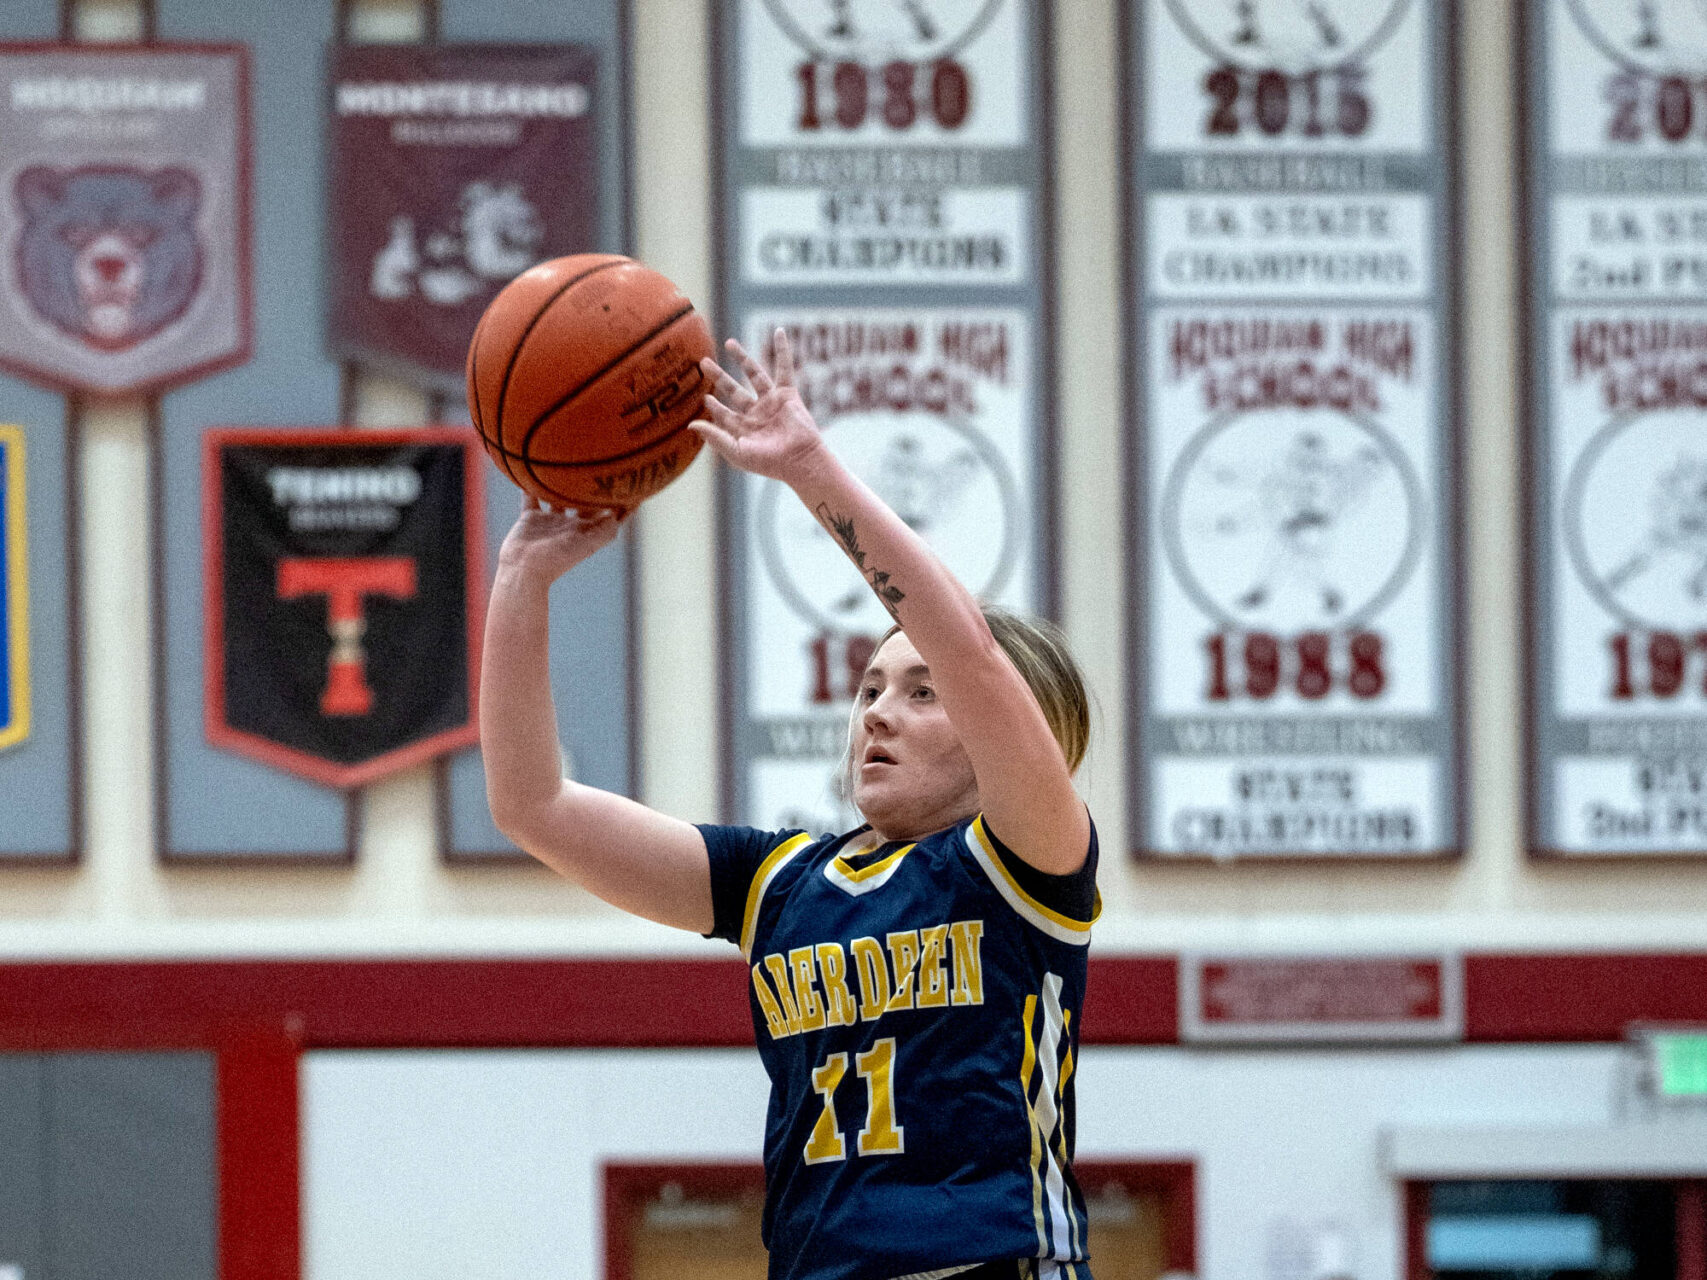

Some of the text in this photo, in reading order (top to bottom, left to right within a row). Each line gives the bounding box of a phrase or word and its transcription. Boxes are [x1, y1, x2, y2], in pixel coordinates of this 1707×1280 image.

[797, 58, 972, 131] 1980
[1205, 66, 1375, 139] 2015
[1605, 72, 1707, 143] 20
[758, 234, 1008, 271] CHAMPIONS
[1343, 320, 1414, 382] HIGH
[1204, 629, 1387, 702] 1988
[751, 919, 985, 1041] ABERDEEN
[803, 1036, 906, 1167] 11
